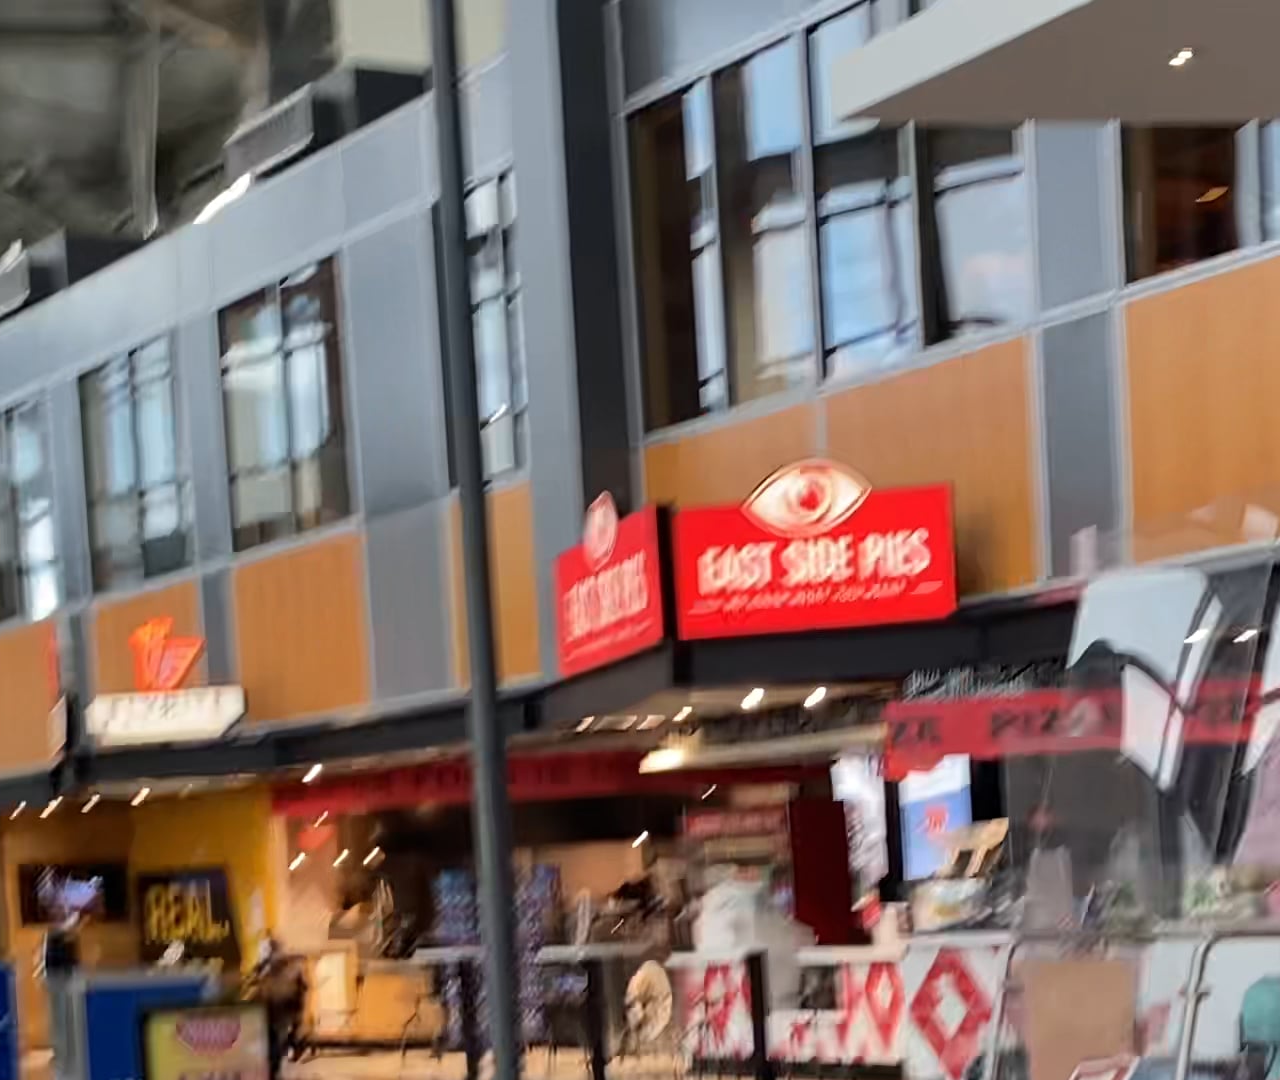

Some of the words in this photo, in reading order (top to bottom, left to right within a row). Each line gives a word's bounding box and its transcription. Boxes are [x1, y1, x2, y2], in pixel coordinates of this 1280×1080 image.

[698, 543, 775, 596] EAST
[780, 534, 855, 587] SIDE
[858, 528, 932, 580] PIES
